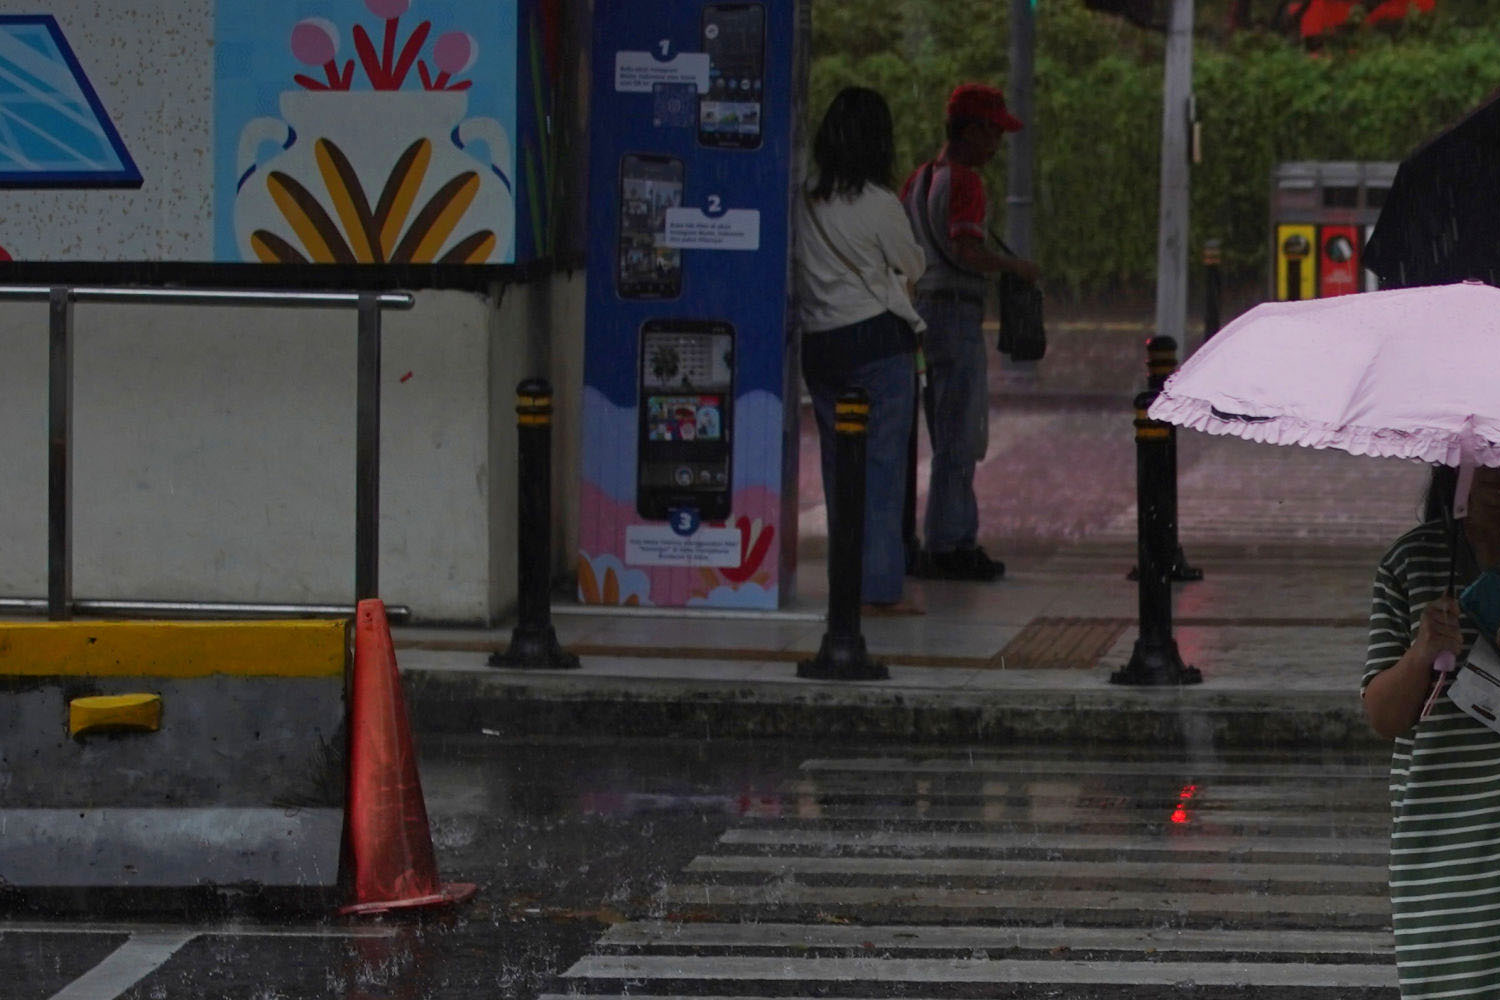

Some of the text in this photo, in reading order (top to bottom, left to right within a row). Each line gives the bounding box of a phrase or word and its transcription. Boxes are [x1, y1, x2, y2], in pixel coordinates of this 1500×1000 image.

[658, 39, 670, 56] 1
[708, 194, 722, 212] 2
[678, 512, 692, 530] 3
